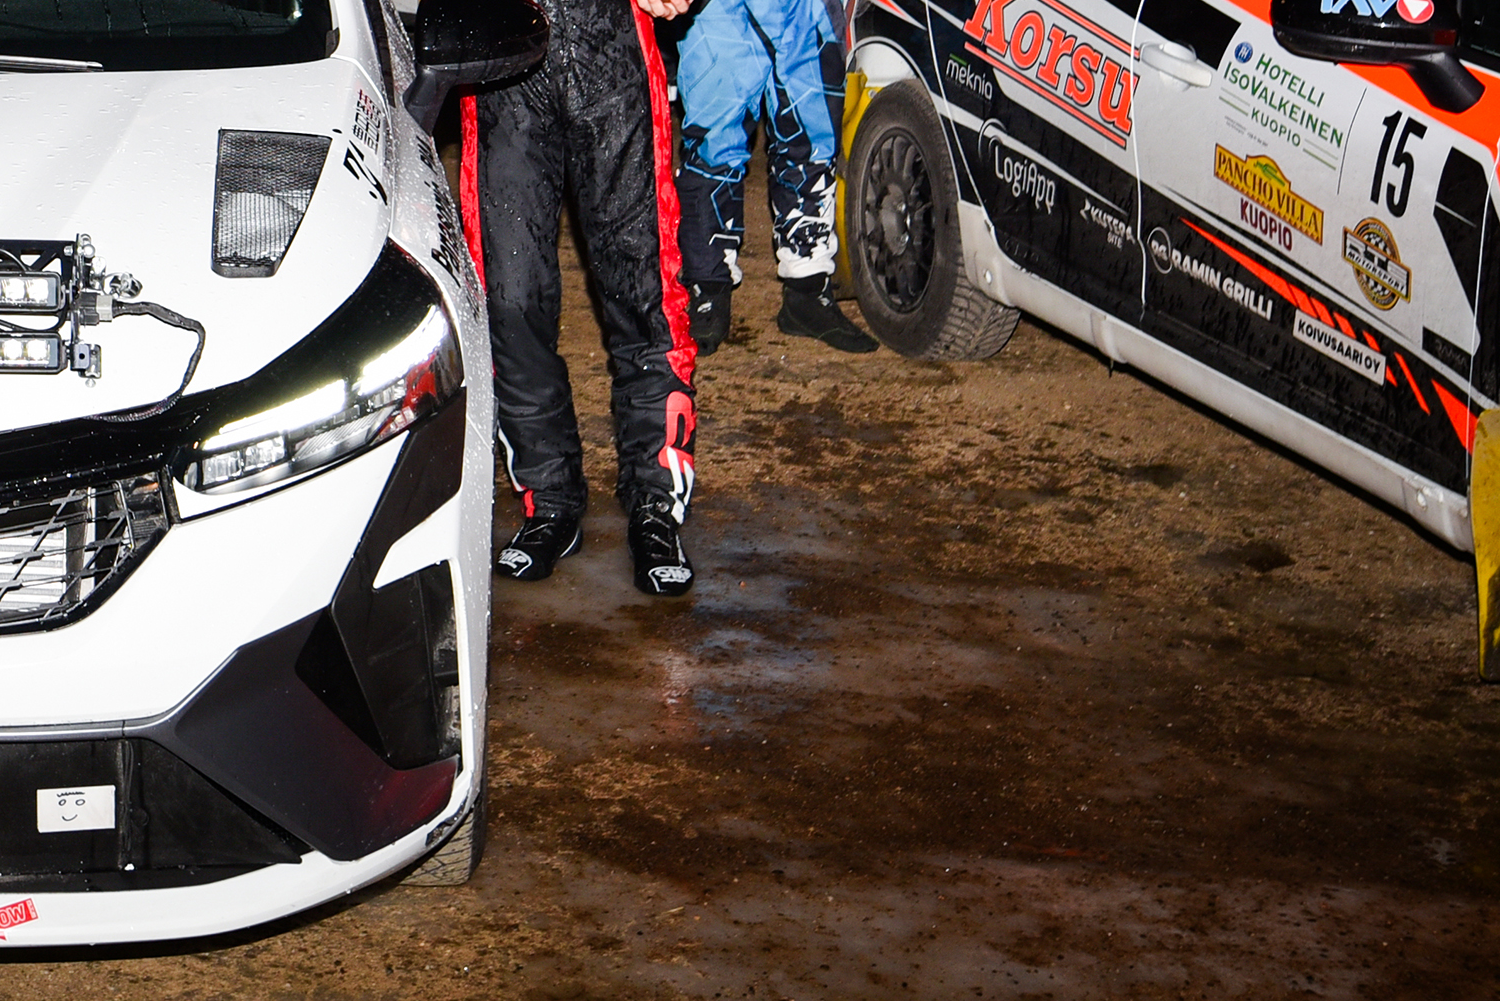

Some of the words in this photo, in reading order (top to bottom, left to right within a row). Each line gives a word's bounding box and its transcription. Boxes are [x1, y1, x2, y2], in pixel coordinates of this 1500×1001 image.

[1255, 52, 1326, 109] HOTELLI
[1250, 107, 1302, 148] KUOPIO
[993, 144, 1056, 215] LogiApp
[1370, 109, 1428, 218] 15
[1217, 151, 1274, 202] PANCHO
[1274, 189, 1321, 235] VILLA
[1239, 197, 1294, 252] KUOPIO
[1171, 248, 1223, 292] RAMIN
[1221, 276, 1274, 322] GRILLI
[1346, 249, 1406, 294] MOTORSPORT
[1296, 319, 1364, 364] KOIVUSAARI
[1363, 354, 1382, 375] OY
